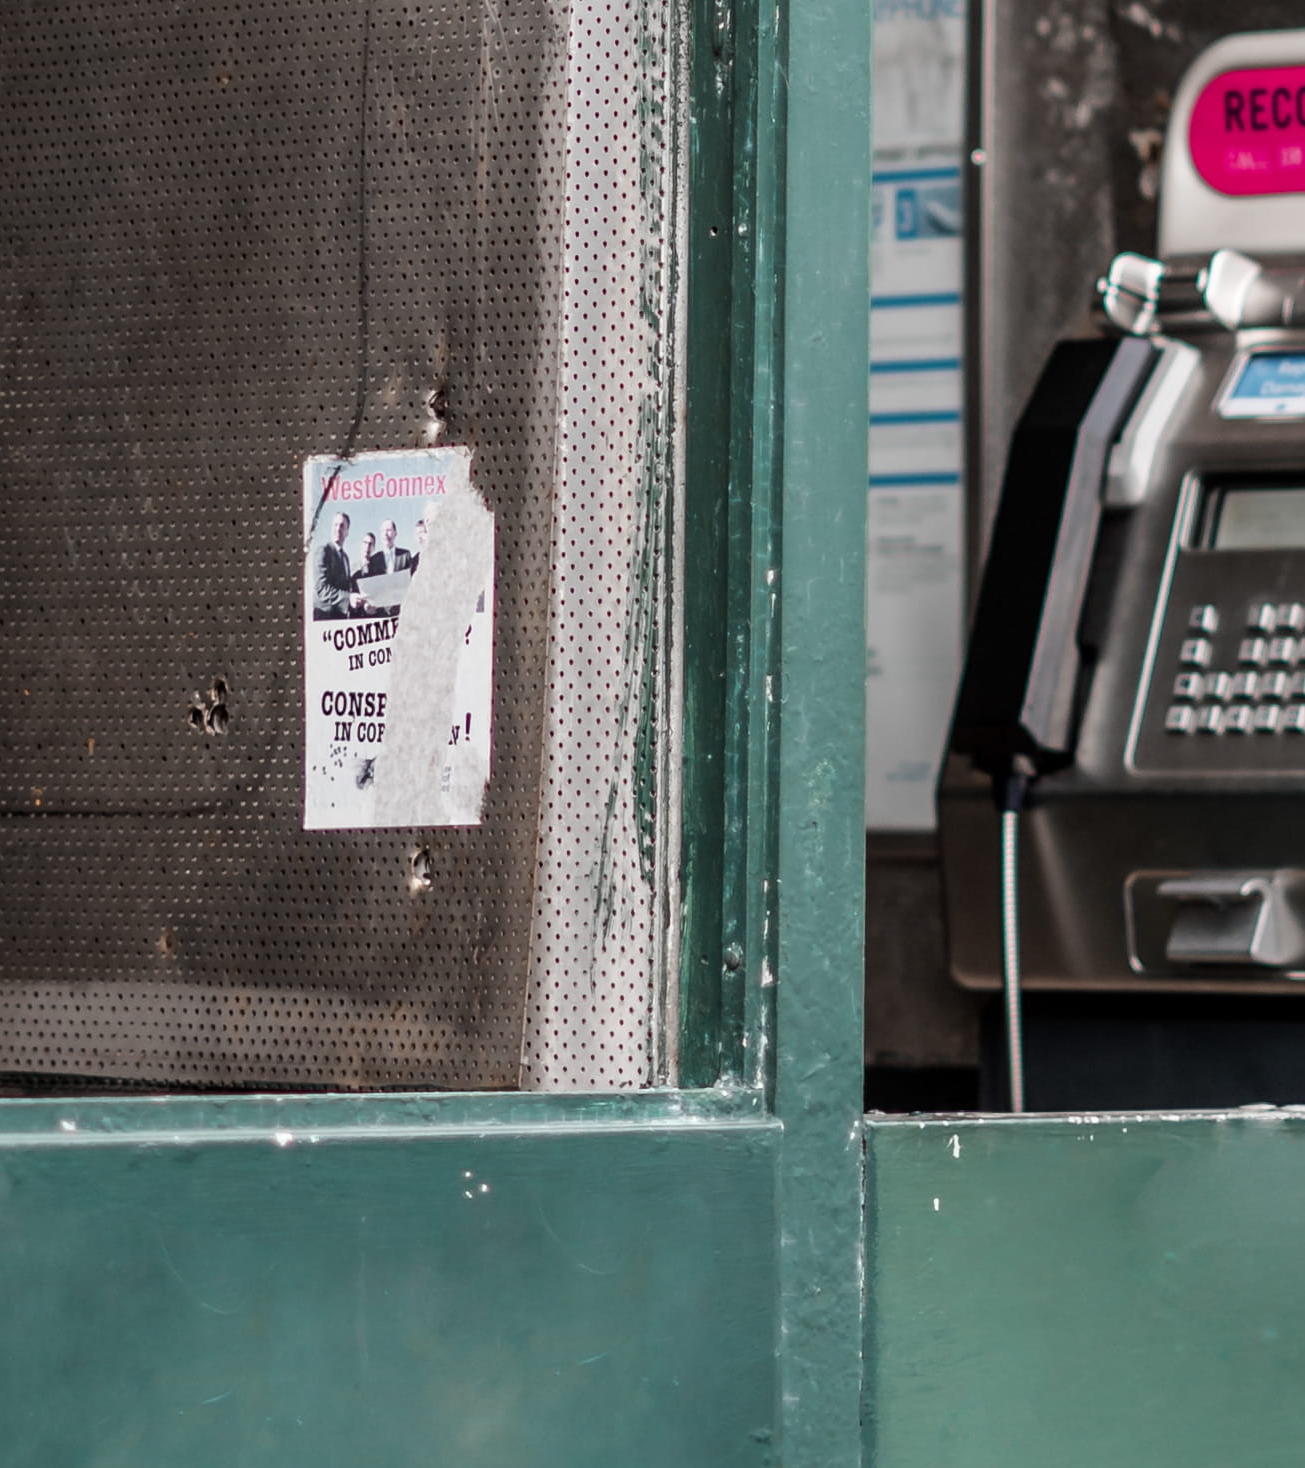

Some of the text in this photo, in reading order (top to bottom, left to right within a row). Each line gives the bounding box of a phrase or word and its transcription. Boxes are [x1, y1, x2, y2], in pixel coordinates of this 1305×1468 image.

[321, 472, 447, 502] WestConnex
[348, 653, 364, 672] IN
[334, 721, 353, 742] IN
